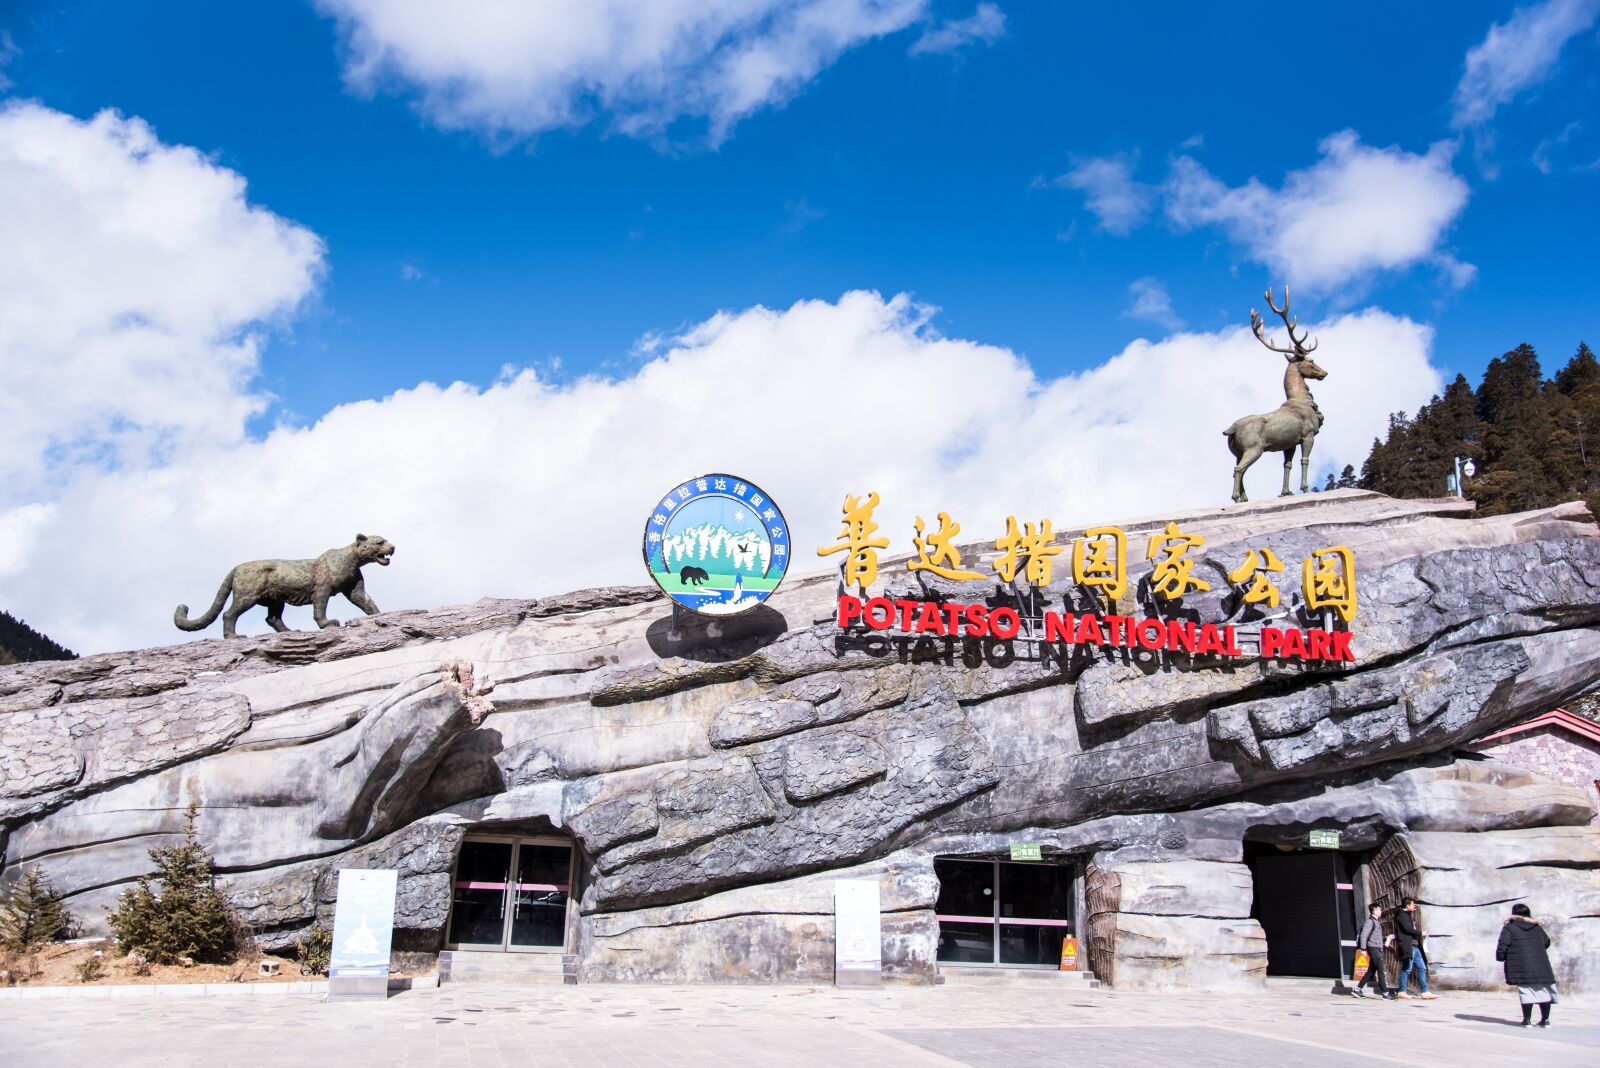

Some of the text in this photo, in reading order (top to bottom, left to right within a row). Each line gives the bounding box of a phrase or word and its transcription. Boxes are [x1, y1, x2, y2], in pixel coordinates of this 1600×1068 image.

[648, 478, 786, 557] 香格里拉普达措国家公园
[817, 491, 1357, 622] 普达措国家公园
[838, 595, 1356, 662] POTATSO NATIONAL PARK
